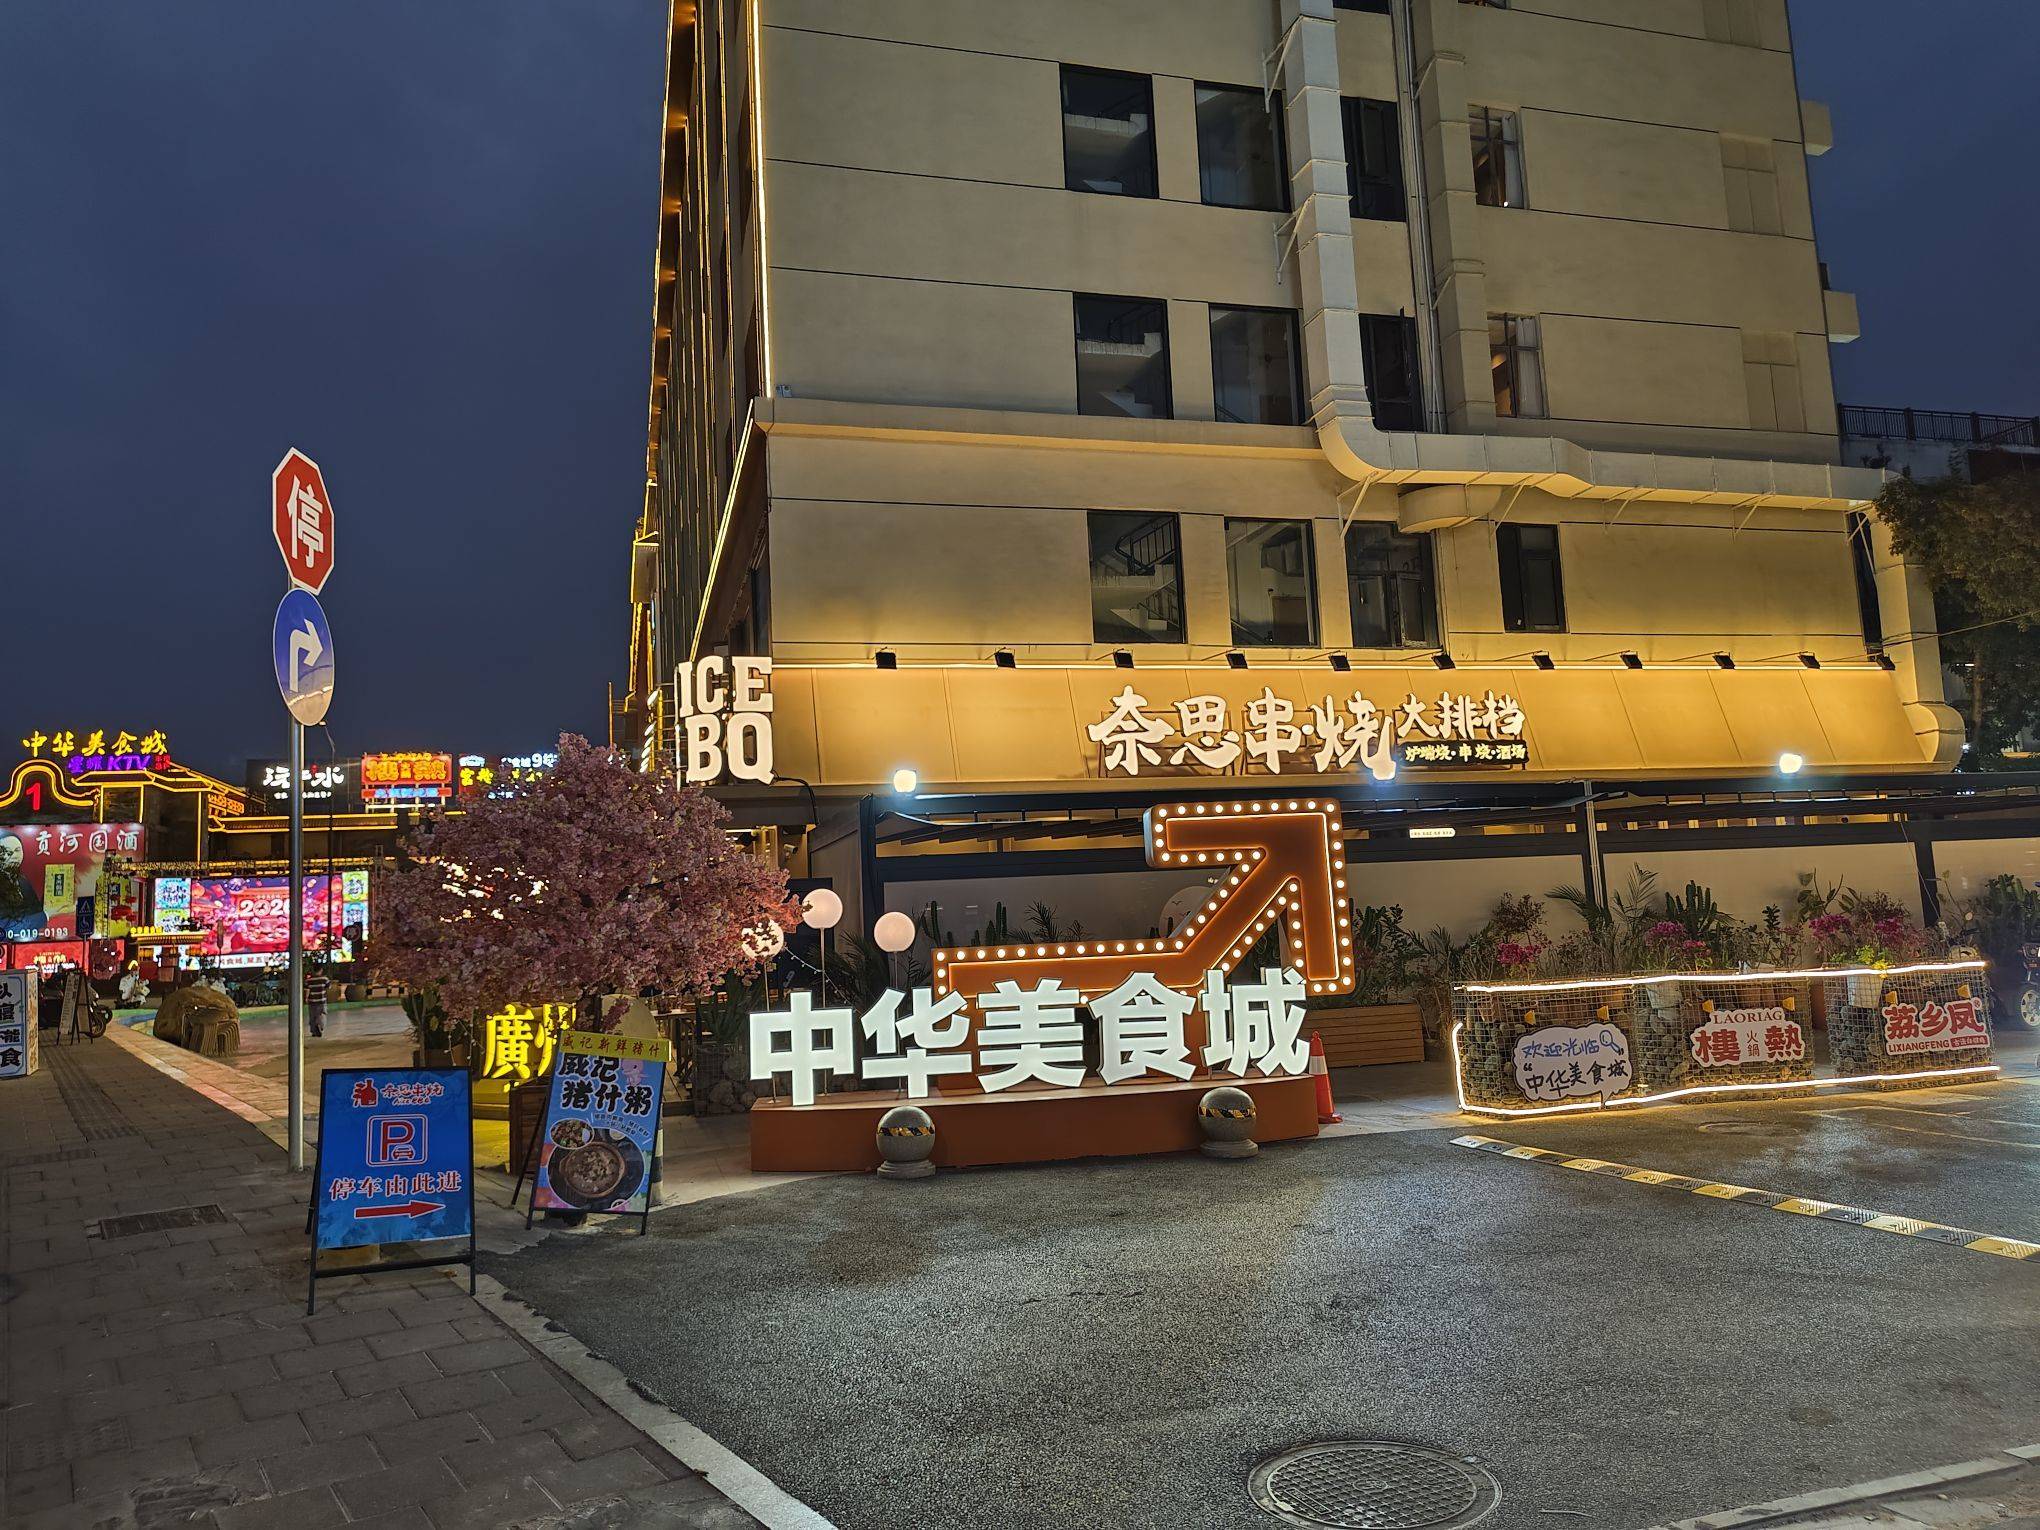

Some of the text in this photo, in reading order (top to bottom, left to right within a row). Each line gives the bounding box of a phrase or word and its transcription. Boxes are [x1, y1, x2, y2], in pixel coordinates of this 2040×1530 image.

[286, 474, 324, 568] 停
[1397, 689, 1526, 740] 大排档
[25, 782, 42, 812] 1
[749, 965, 1312, 1108] 中华美食城
[1521, 1038, 1600, 1058] 欢迎光临
[1695, 1028, 1741, 1063] 樓
[1888, 1040, 1950, 1053] LIXIANGFENG
[561, 1079, 653, 1116] 猪什粥
[380, 1120, 415, 1162] P
[329, 1170, 463, 1201] 停车由此进
